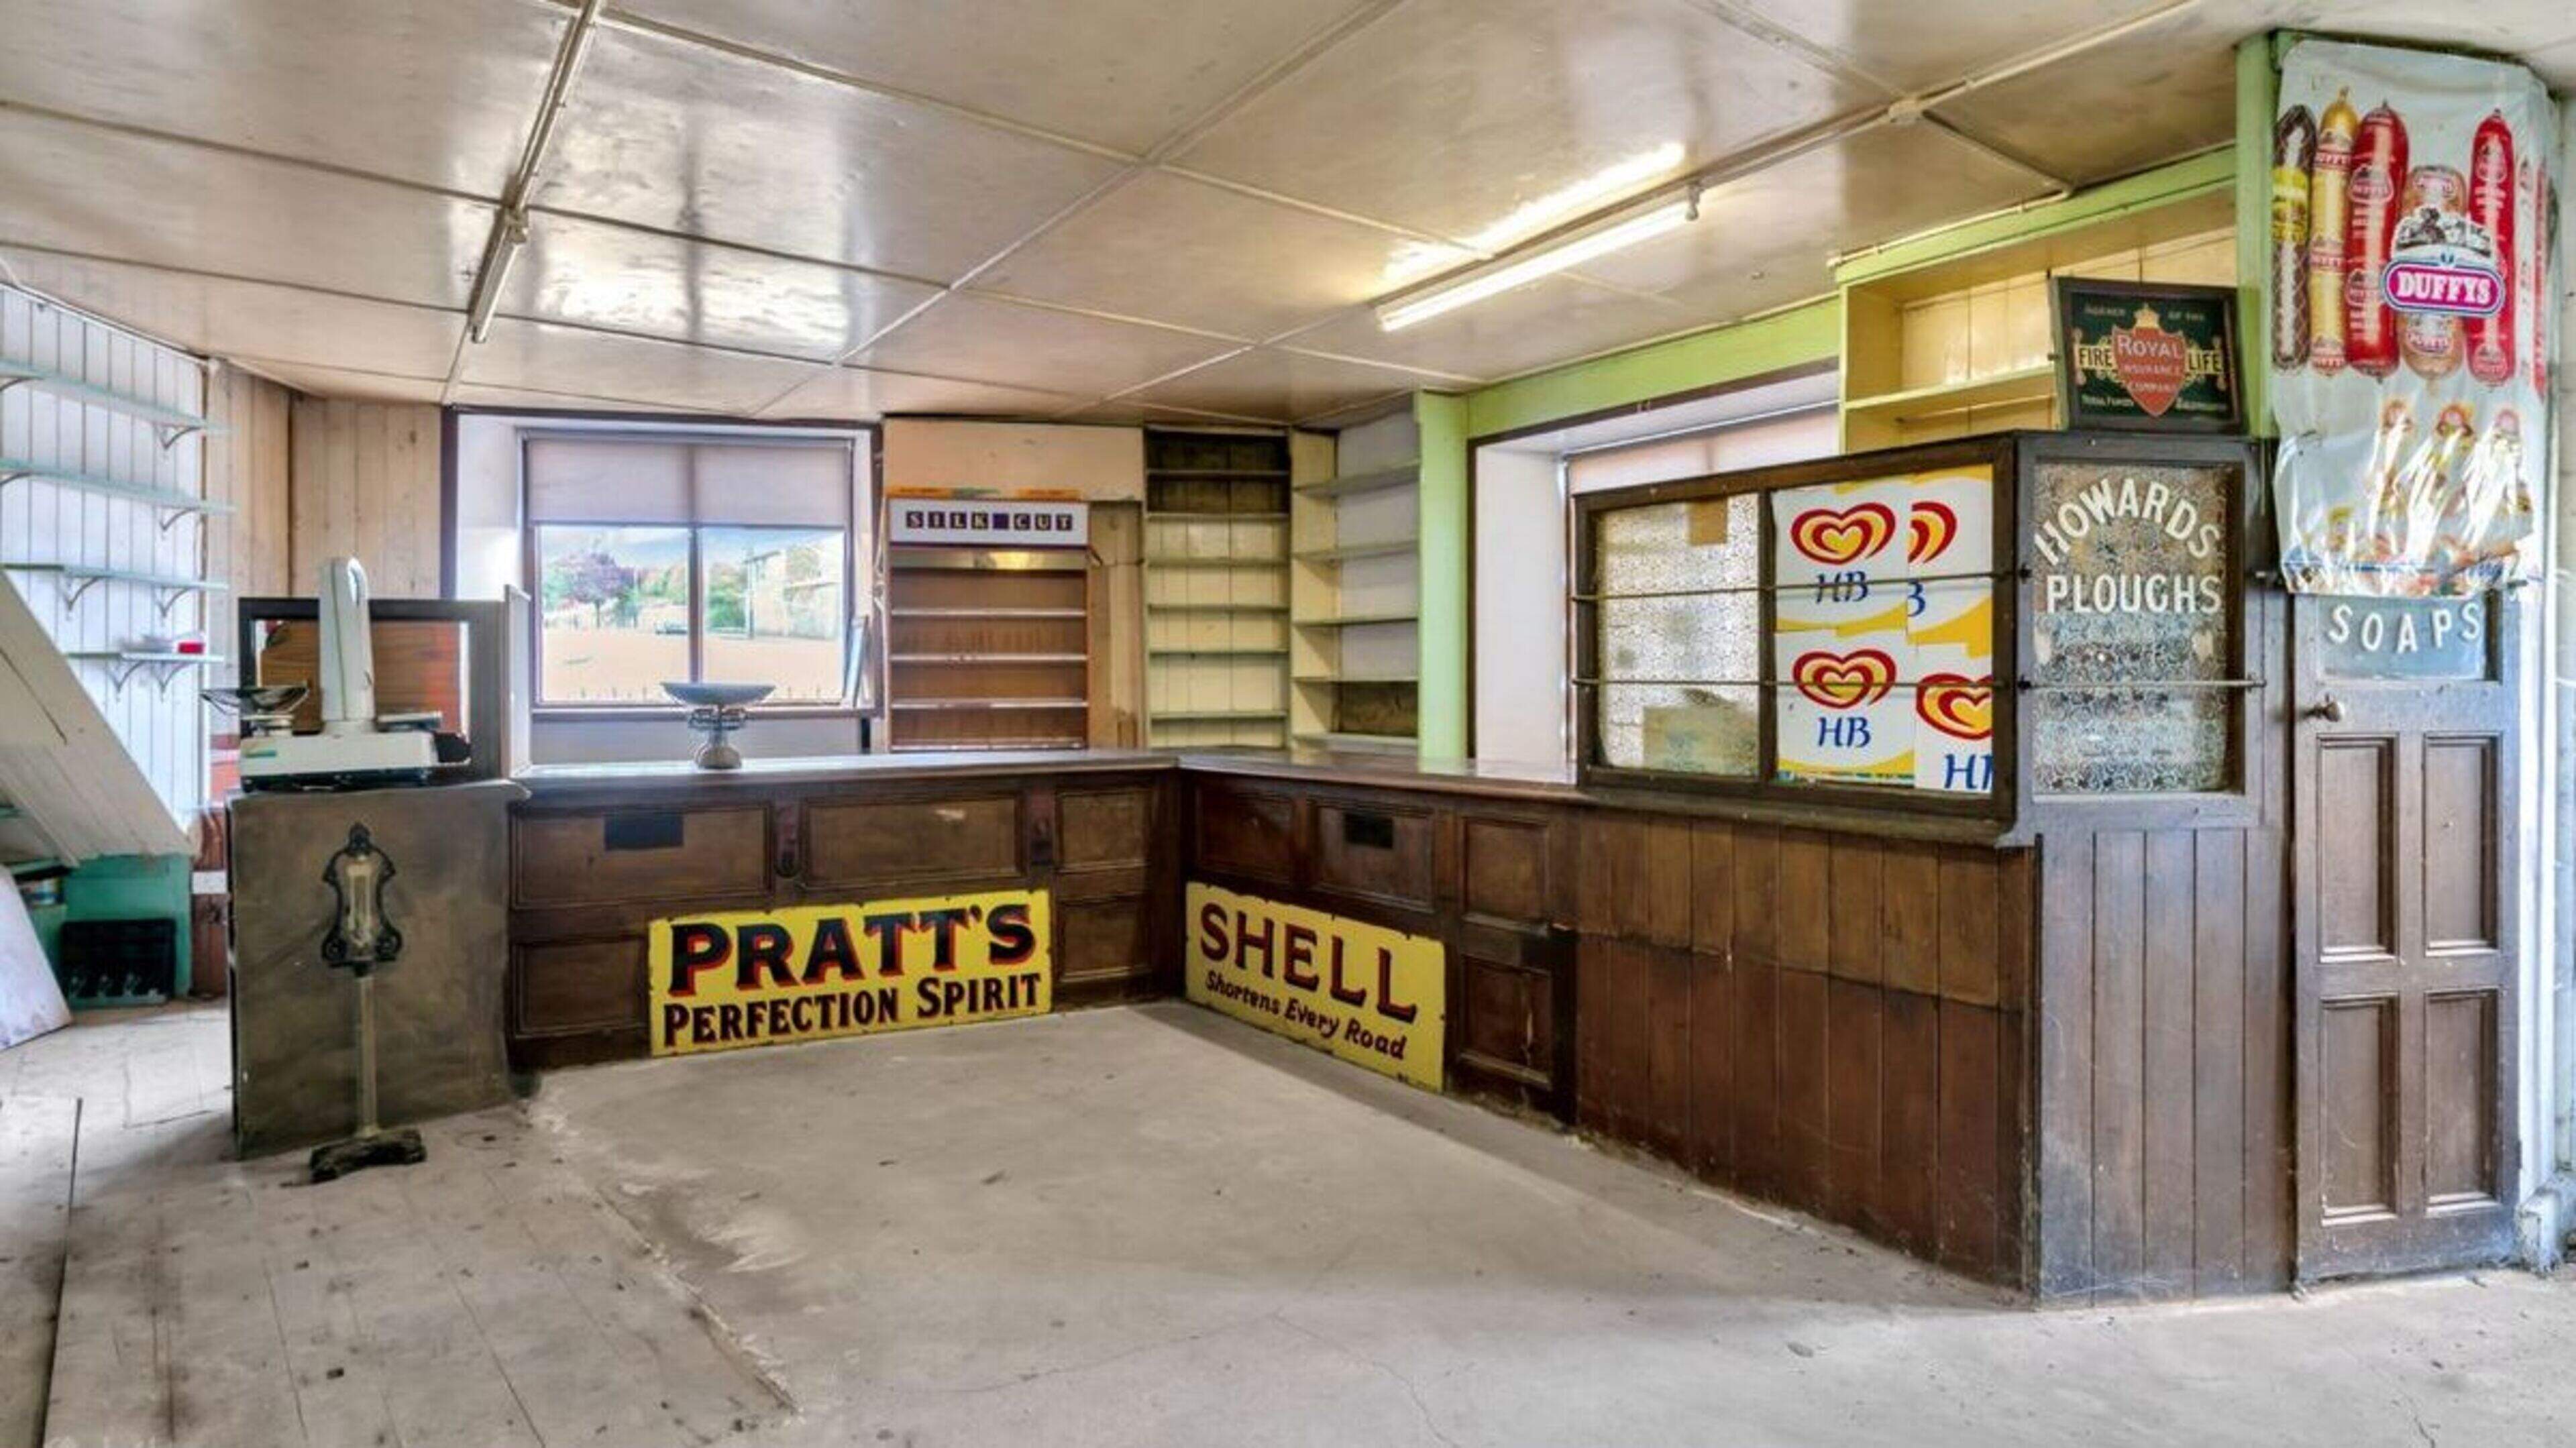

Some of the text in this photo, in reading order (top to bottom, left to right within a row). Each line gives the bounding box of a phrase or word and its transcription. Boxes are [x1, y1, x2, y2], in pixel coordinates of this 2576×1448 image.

[2396, 271, 2491, 304] DUFFYS
[2079, 347, 2113, 368] FIRE
[2117, 334, 2182, 360] ROYAL
[2188, 351, 2222, 372] LIFE
[906, 510, 1073, 531] SILK CUT
[2034, 478, 2220, 566] HOWARDS
[1815, 570, 1869, 605] HB
[2046, 572, 2222, 615] PLOUGHS
[2328, 602, 2483, 655] SOAPS
[1817, 716, 1872, 748] HB
[667, 904, 1036, 997] PRATT'S
[1199, 901, 1417, 1024] SHELL
[663, 972, 1042, 1048] PERFECTION SPIRIT
[1206, 970, 1408, 1061] Shortens Every Road
